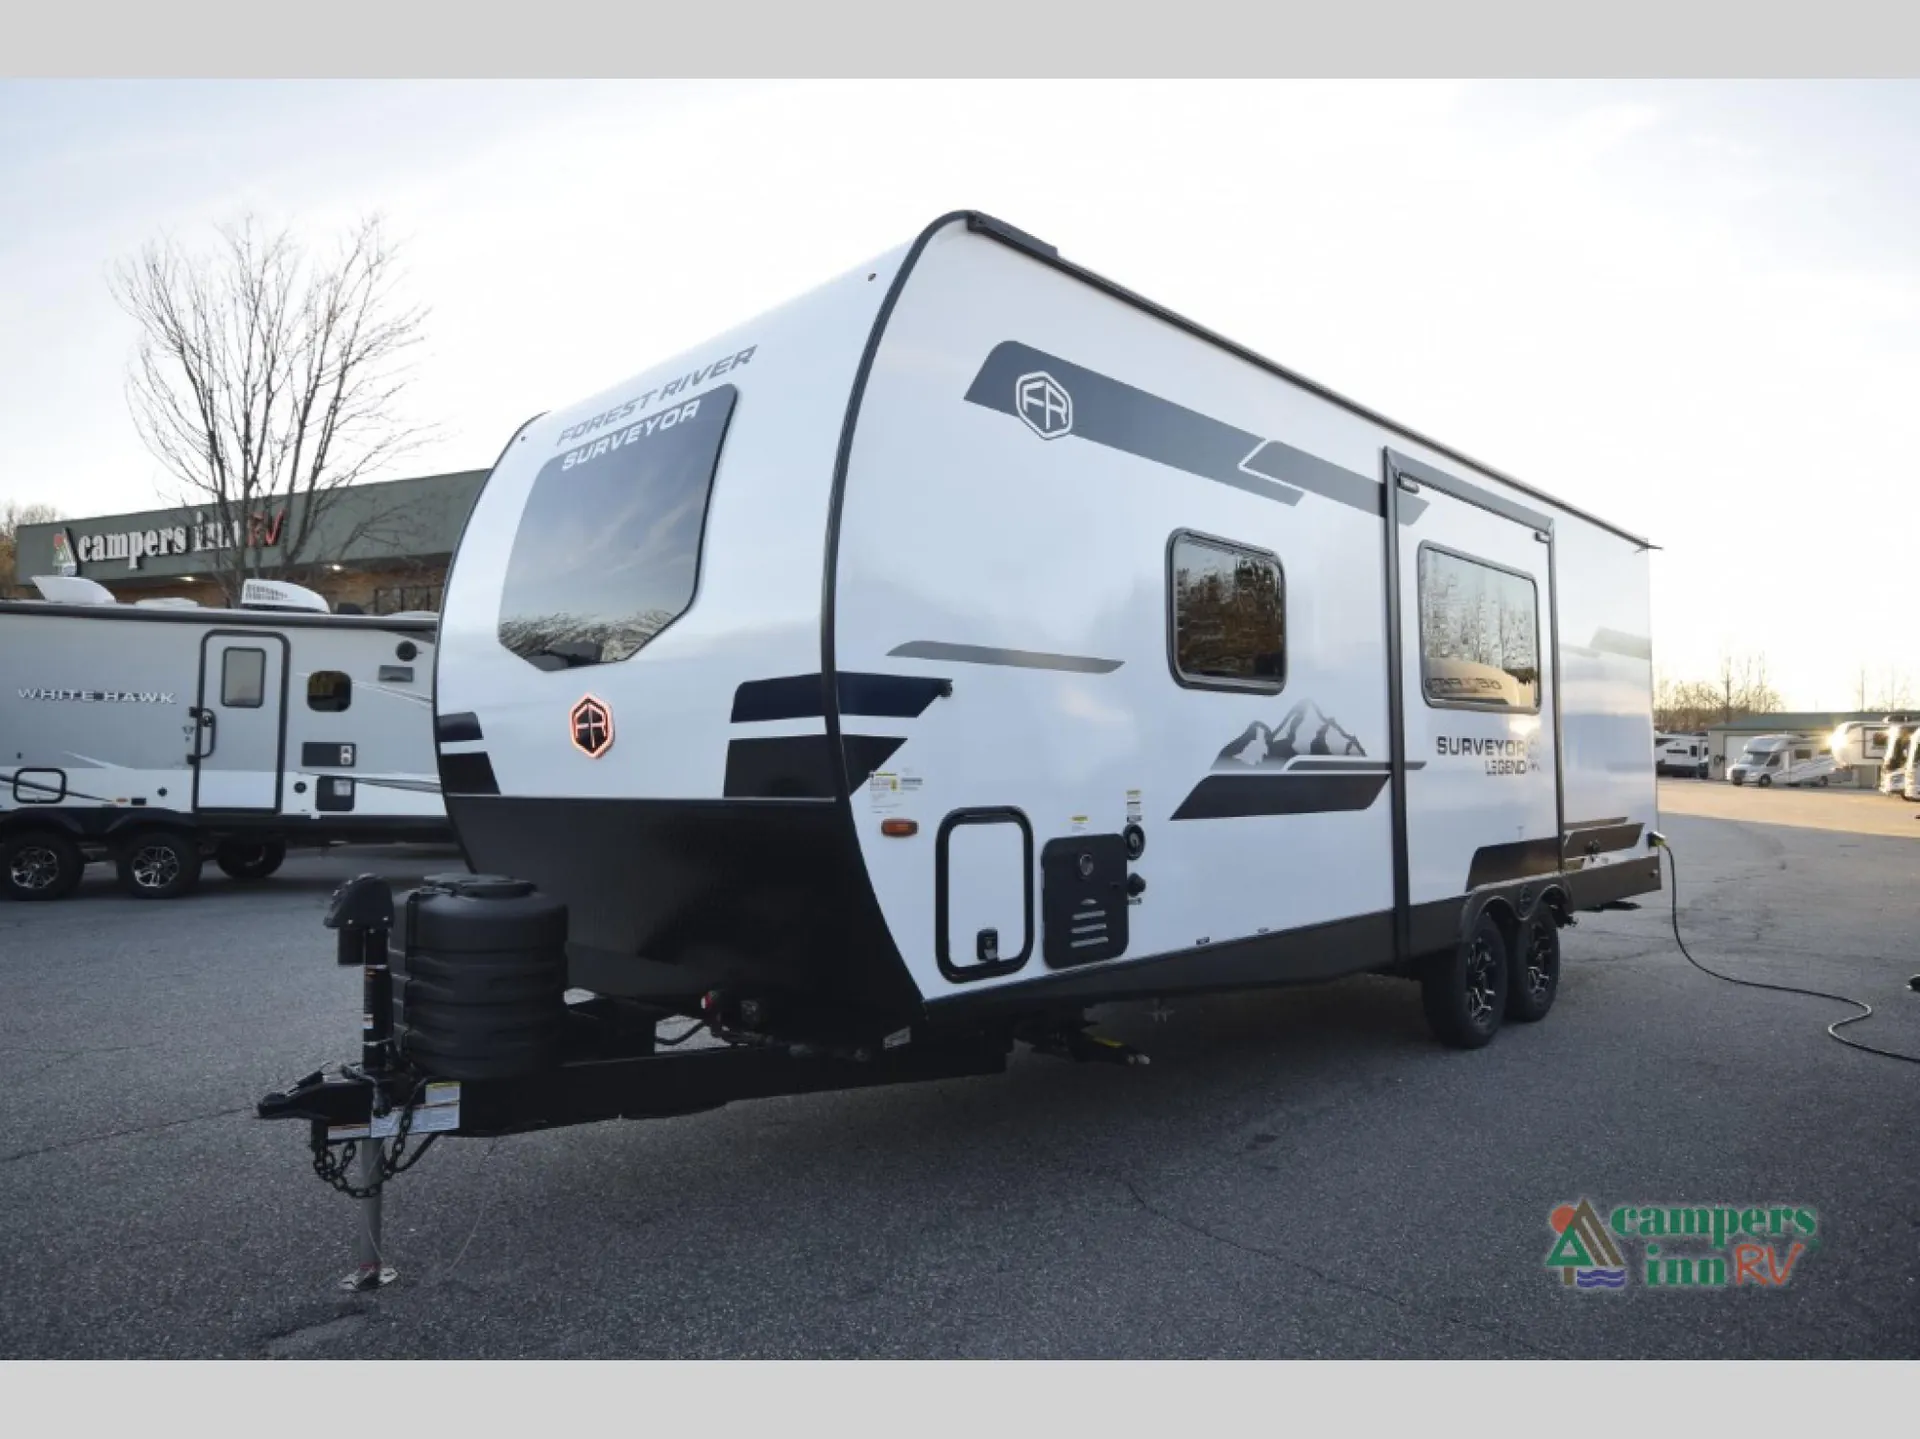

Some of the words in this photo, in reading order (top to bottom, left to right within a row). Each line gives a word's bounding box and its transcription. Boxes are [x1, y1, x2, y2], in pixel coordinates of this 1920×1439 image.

[556, 389, 658, 447] FOREST
[658, 344, 759, 401] RIVER
[560, 398, 701, 472] SURVEYOR
[78, 525, 187, 571] campers
[18, 687, 94, 703] WHITE
[103, 691, 177, 705] HAWK
[1436, 735, 1526, 756] SURVEYOR
[1485, 759, 1527, 775] LEGEND
